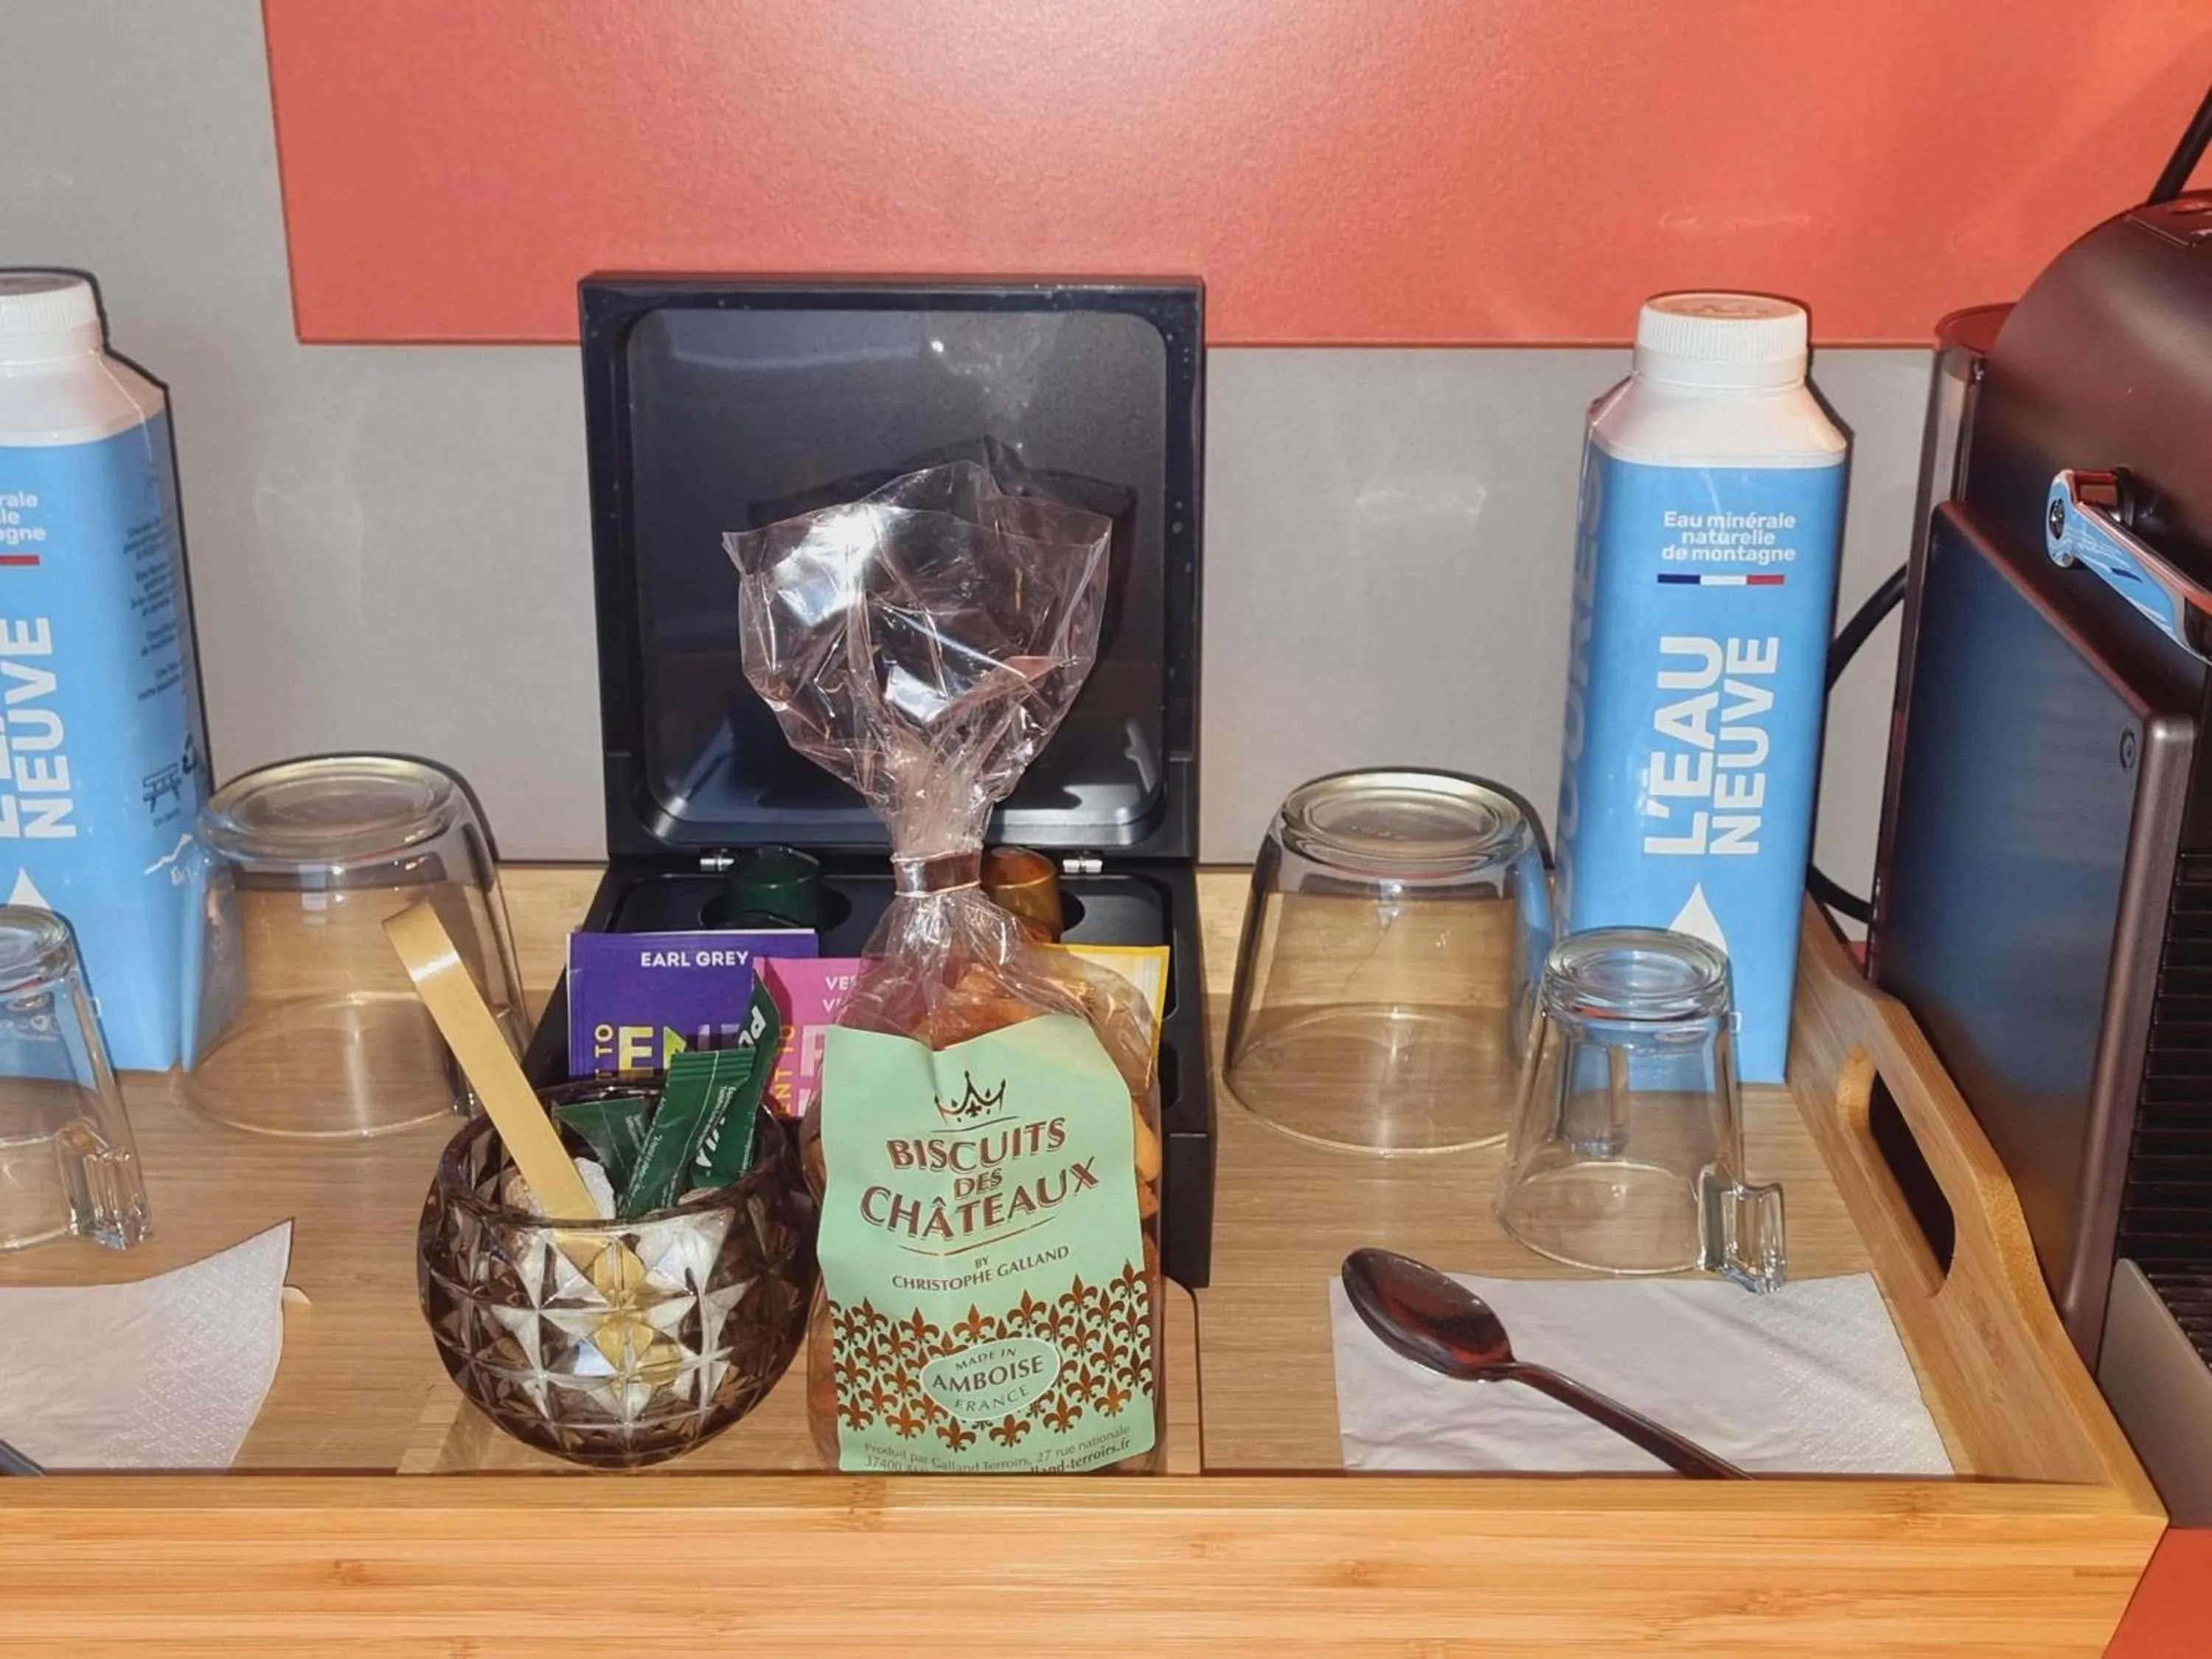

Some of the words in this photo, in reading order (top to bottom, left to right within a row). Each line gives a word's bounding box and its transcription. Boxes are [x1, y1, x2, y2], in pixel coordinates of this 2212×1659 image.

[1663, 511, 1703, 528] Eau
[1707, 510, 1795, 529] minérale
[1681, 529, 1775, 546] naturelle
[1662, 546, 1688, 561] de
[1691, 546, 1795, 566] montagne
[0, 617, 77, 838] NEUVE
[1644, 636, 1723, 855] L'EAU
[1709, 636, 1779, 855] NEUVE
[641, 952, 691, 967] EARL
[696, 950, 748, 967] GREY
[886, 1117, 1067, 1175] BISCUITS
[860, 1155, 1101, 1242] CHÂTEAUX
[953, 1166, 1004, 1200] DES
[891, 1269, 993, 1291] CHRISTOPHE
[997, 1245, 1070, 1277] GALLAND
[975, 1256, 990, 1269] BY
[932, 1354, 1044, 1394] AMBOISE
[955, 1350, 995, 1371] MADE
[1001, 1347, 1017, 1358] IN
[954, 1384, 1029, 1413] FRANCE
[1055, 1444, 1077, 1458] rue
[1077, 1424, 1130, 1452] nationale
